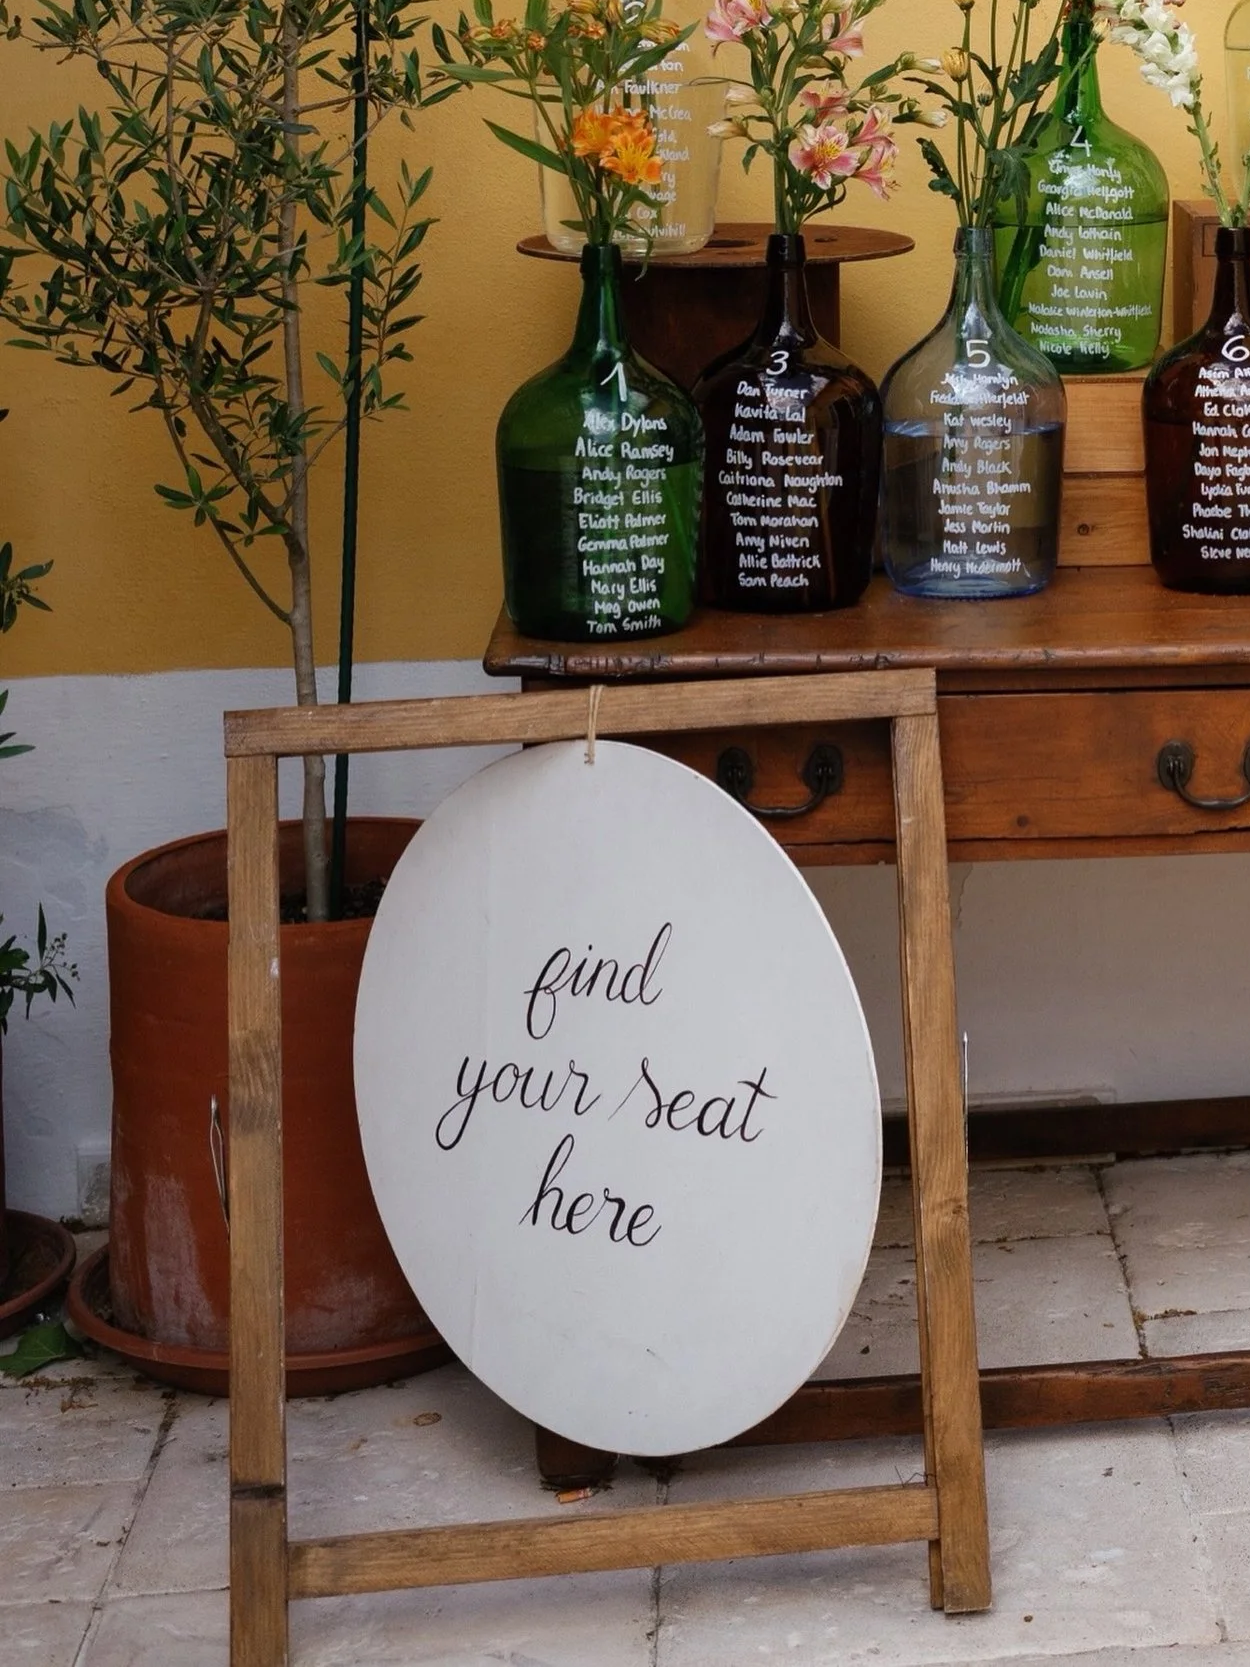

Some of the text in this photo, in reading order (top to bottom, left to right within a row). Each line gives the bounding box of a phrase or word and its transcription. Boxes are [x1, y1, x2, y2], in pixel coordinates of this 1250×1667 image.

[624, 79, 680, 95] Faulkner
[1069, 125, 1094, 158] 4
[1045, 202, 1134, 220] Alice McDonald
[1043, 223, 1075, 246] Andy
[1039, 244, 1134, 265] Daniel Whitfield
[1051, 283, 1071, 299] Joe
[1082, 324, 1122, 344] Sherry
[965, 339, 991, 369] 5
[1039, 340, 1110, 360] Nicole Kelly
[1221, 334, 1250, 362] 6
[765, 350, 790, 375] 3
[600, 362, 629, 402] 1
[736, 380, 761, 398] Dan
[734, 402, 779, 420] Kavita
[943, 412, 964, 427] Kat
[1203, 401, 1220, 418] Ed
[729, 423, 815, 445] Adam Fowler
[1192, 420, 1238, 439] Hannah
[575, 436, 675, 463] Alice Ramsey
[943, 433, 1012, 456] Amy Rogers
[725, 448, 753, 471] Billy
[942, 457, 1013, 479] Andy Black
[582, 465, 667, 491] Andy Rogers
[573, 488, 662, 510] Bridget Ellis
[725, 491, 818, 508] Catherine Mac
[1200, 482, 1234, 502] Lydia
[938, 499, 1012, 519] Jamie Taylor
[625, 513, 667, 529] Palmer
[729, 512, 758, 527] Tom
[944, 518, 1011, 535] Jess Martin
[577, 534, 670, 553] Gemma Palmer
[735, 532, 810, 553] Amy Niven
[942, 539, 1007, 556] Matt Lewis
[582, 555, 666, 577] Hannah Day
[739, 553, 769, 570] Allie
[591, 577, 658, 602] Mary Ellis
[770, 572, 810, 588] Peach
[594, 600, 622, 620] Meg
[586, 615, 662, 634] Tom Smith
[523, 922, 672, 1039] find
[435, 1055, 779, 1150] your seat
[518, 1133, 663, 1247] here
